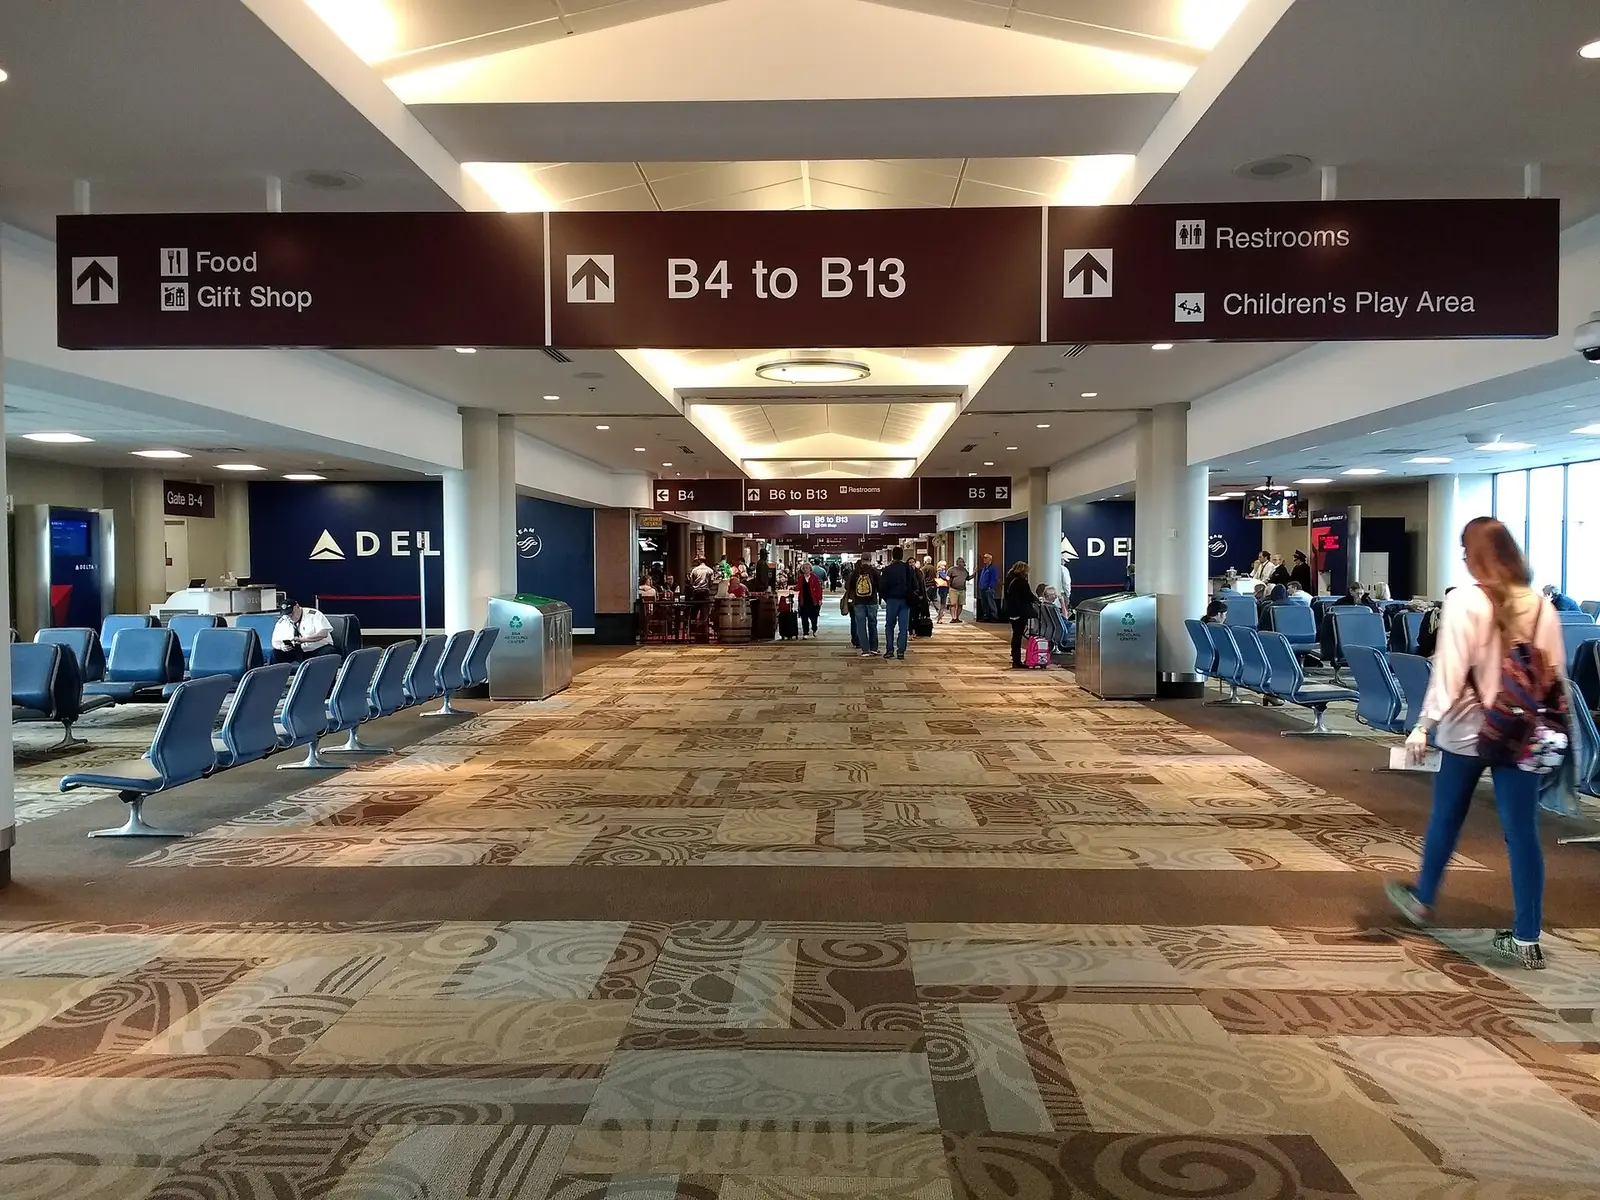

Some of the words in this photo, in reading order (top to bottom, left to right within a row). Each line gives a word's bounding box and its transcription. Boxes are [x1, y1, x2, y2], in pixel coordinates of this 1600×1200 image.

[1215, 226, 1351, 249] Restrooms
[196, 251, 258, 273] Food
[667, 257, 733, 299] B4
[751, 259, 799, 299] to
[821, 256, 907, 298] B13
[197, 285, 241, 308] Gift
[249, 285, 312, 312] Shop
[1222, 290, 1347, 315] Children's
[1356, 290, 1409, 317] Play
[1416, 289, 1476, 313] Area
[678, 489, 694, 501] B4
[769, 489, 786, 500] B6
[789, 489, 802, 500] to
[806, 489, 828, 500] B13
[848, 485, 881, 494] Restrooms
[968, 487, 986, 499] B5
[167, 490, 186, 506] Gate
[188, 493, 203, 507] B-4
[826, 516, 834, 524] to
[835, 515, 849, 524] B13
[516, 527, 535, 537] EAM
